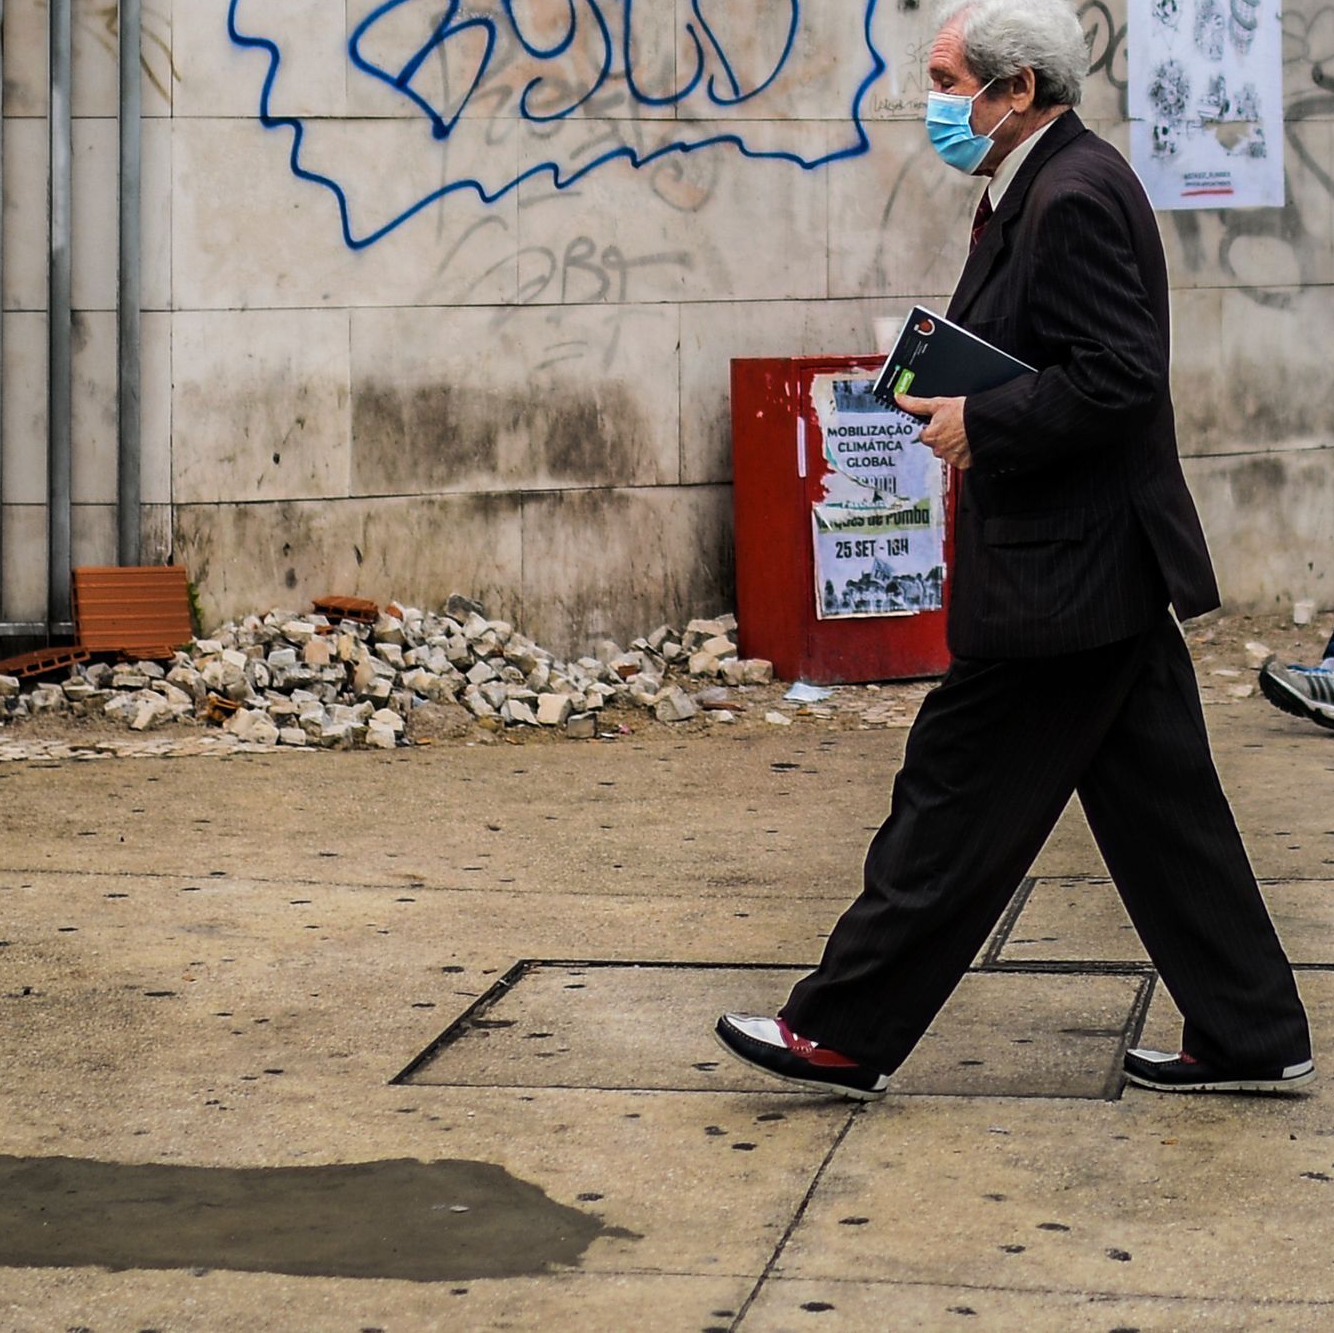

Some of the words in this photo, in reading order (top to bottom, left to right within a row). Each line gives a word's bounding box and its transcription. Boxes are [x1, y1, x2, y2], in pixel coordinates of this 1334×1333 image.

[827, 423, 913, 439] MOBILIZAÇÃO
[837, 439, 904, 453] CLIMÁTICA
[846, 456, 896, 468] GLOBAL
[835, 541, 853, 559] 25
[854, 539, 877, 558] SET
